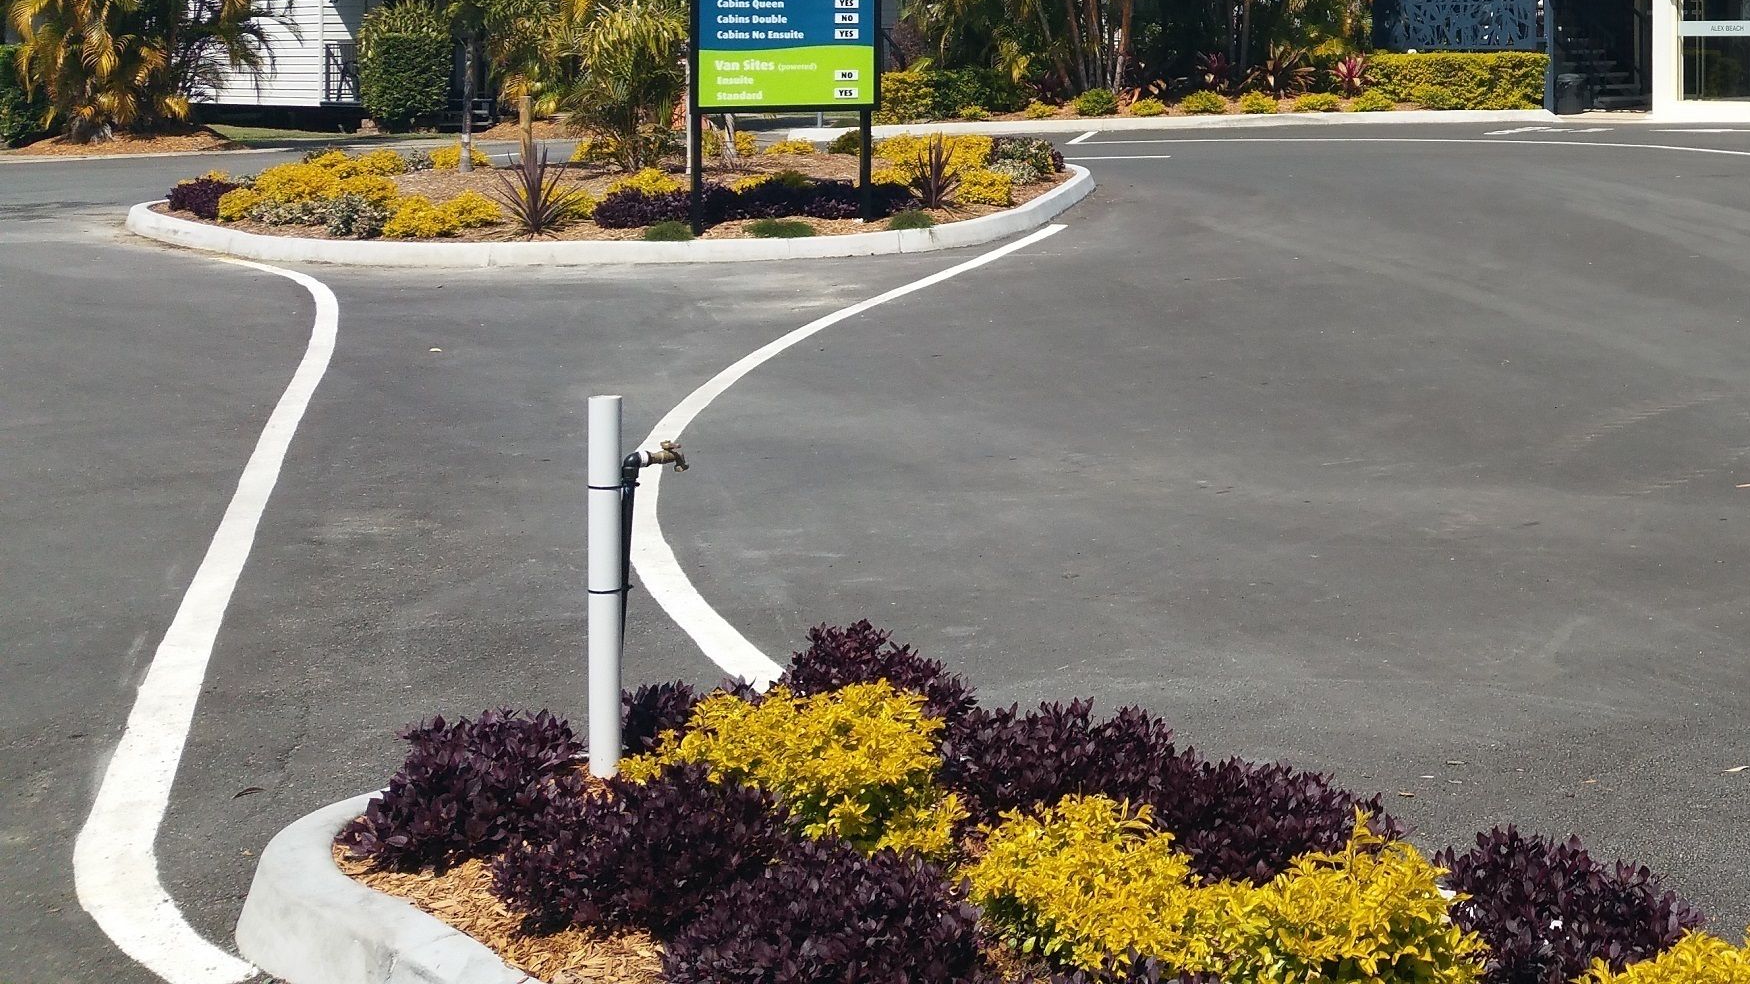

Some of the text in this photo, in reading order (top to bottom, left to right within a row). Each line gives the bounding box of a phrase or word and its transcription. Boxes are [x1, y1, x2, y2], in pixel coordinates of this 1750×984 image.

[717, 0, 750, 8] Cabins
[752, 0, 784, 9] Queen
[717, 15, 750, 24] Cabins
[752, 15, 787, 24] Double
[717, 30, 750, 39] Cabins
[752, 30, 765, 39] No
[768, 30, 804, 39] Ensuite
[715, 60, 739, 71] Van
[743, 59, 775, 71] Sites
[717, 76, 754, 85] Ensuite
[717, 90, 762, 100] Standard
